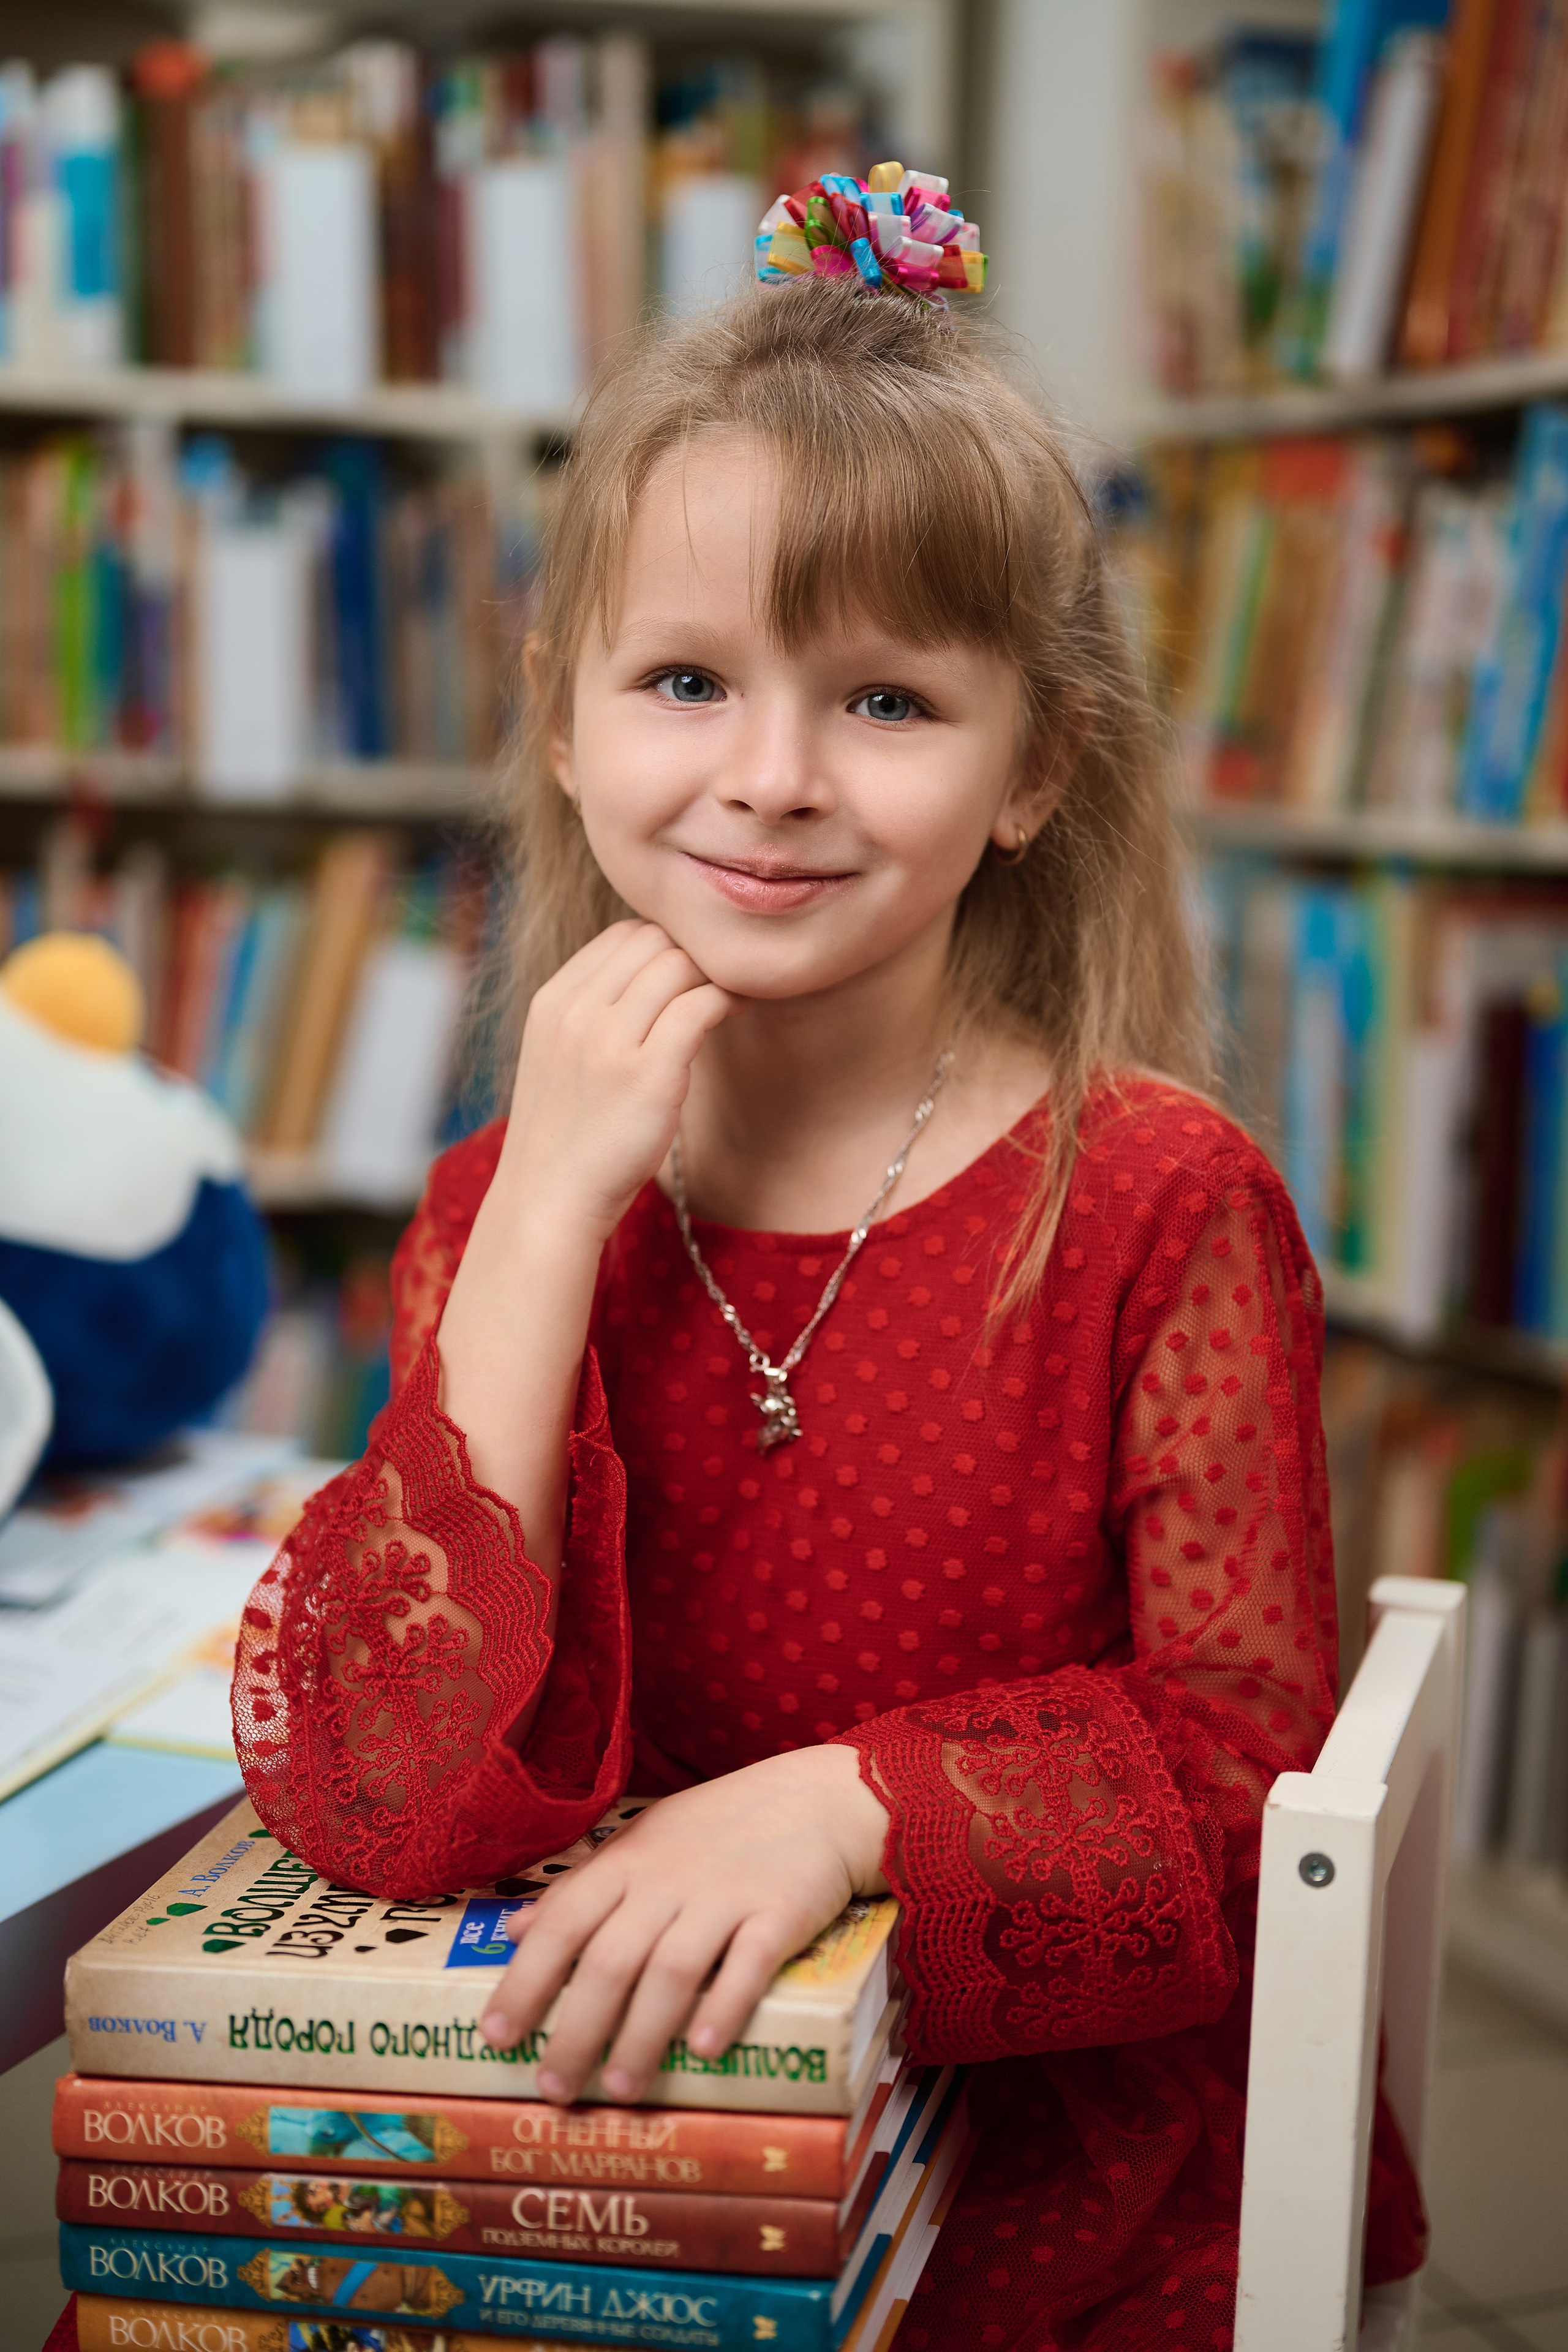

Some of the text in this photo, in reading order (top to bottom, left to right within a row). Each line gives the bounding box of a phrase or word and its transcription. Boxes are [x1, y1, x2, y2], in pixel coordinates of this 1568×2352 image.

[178, 1884, 211, 1898] А.
[203, 1850, 319, 1937] ВОЛШЕ
[379, 1888, 467, 1922] ГО
[265, 1883, 381, 1958] ИЗУМ
[471, 1943, 507, 1955] 6
[183, 2019, 207, 2043] А.
[660, 2040, 826, 2082] ВОЛШЕБН
[83, 2109, 227, 2149] ВОЛКОВ
[512, 2112, 678, 2151] ОГНЕННЫЙ
[490, 2146, 703, 2184] БОГ МАРРАНОВ
[89, 2174, 230, 2216] ВОЛКОВ
[511, 2187, 650, 2237] СЕМЬ
[481, 2226, 681, 2258] ПОДЗЕМНЫХ КОРОЛЕЙ
[89, 2245, 228, 2288] ВОЛКОВ
[478, 2274, 719, 2328] УРФИН ДЖЮС
[480, 2308, 492, 2323] И
[497, 2309, 529, 2326] ЕГО
[108, 2315, 249, 2352] ВОЛКОВ
